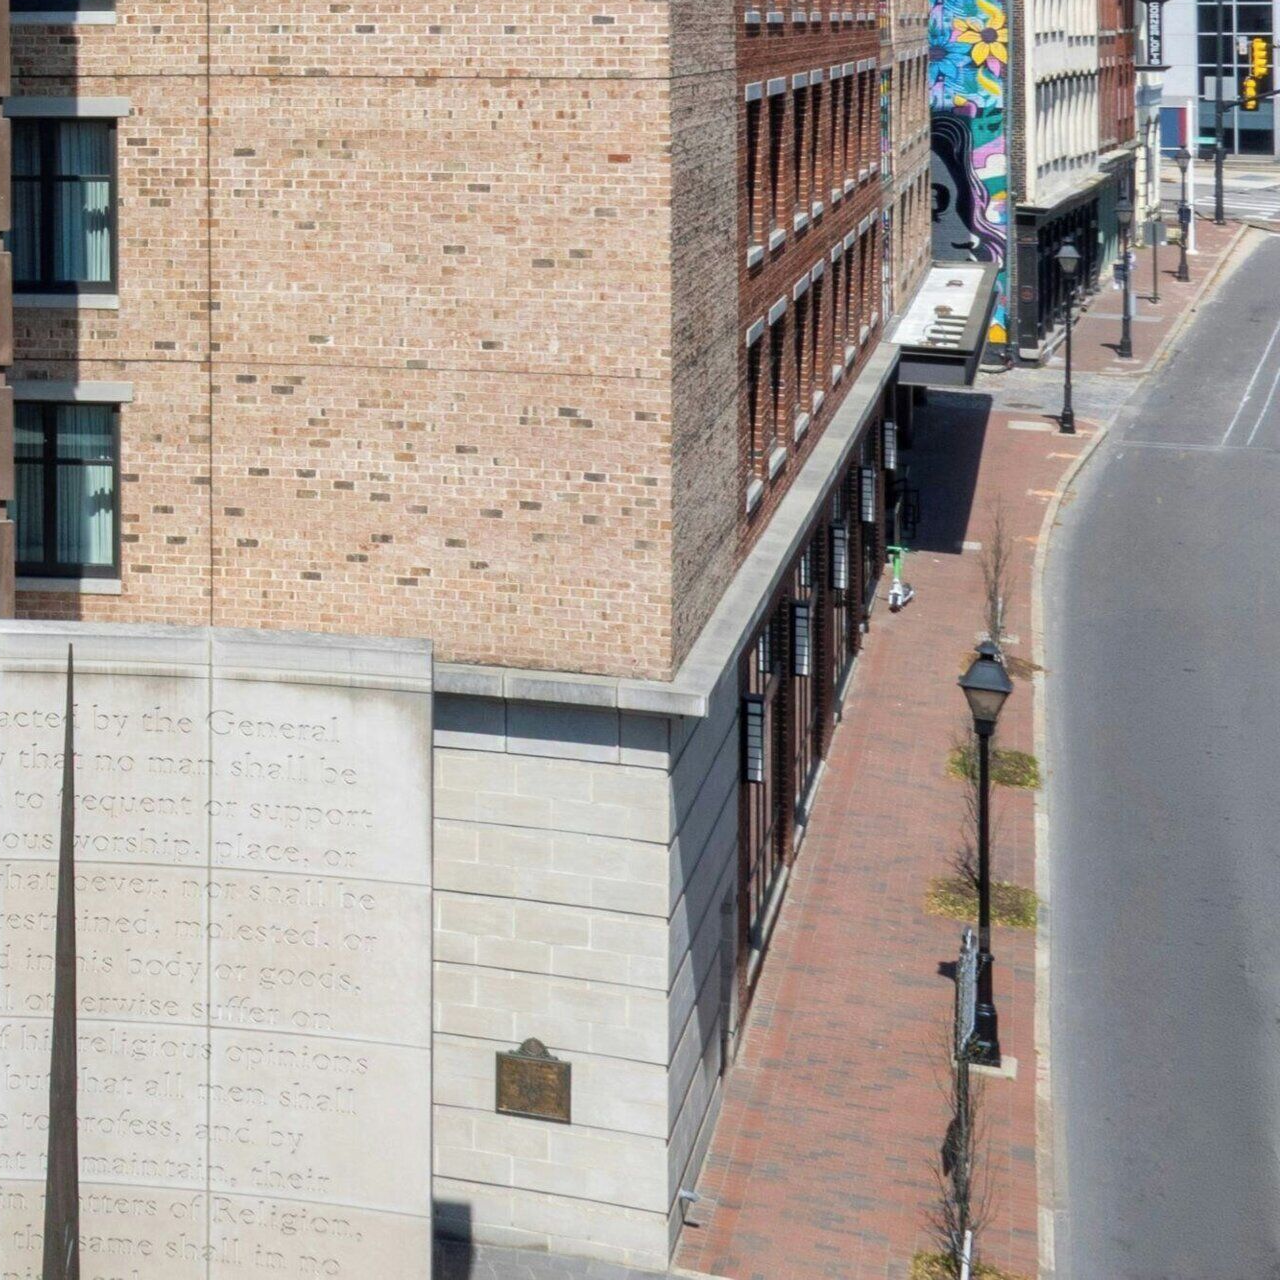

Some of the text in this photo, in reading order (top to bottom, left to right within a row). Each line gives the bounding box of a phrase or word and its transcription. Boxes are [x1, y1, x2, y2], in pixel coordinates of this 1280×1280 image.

[93, 704, 129, 737] by
[142, 706, 193, 734] the
[205, 709, 341, 743] General
[95, 753, 135, 773] no
[148, 755, 219, 776] man
[230, 752, 309, 783] shall
[319, 756, 358, 786] be
[15, 790, 44, 810] to
[204, 799, 238, 818] or
[249, 800, 374, 831] support
[323, 848, 362, 868] or
[182, 879, 237, 901] nor
[249, 876, 326, 907] shall
[337, 881, 376, 912] be
[344, 933, 378, 953] or
[26, 948, 55, 971] in
[125, 948, 202, 983] body
[215, 964, 247, 982] or
[25, 992, 180, 1017] oterwise
[192, 995, 280, 1025] suffer
[290, 1011, 336, 1031] on
[20, 1025, 53, 1052] hi
[77, 1028, 212, 1061] religious
[225, 1042, 369, 1076] opinions
[77, 1066, 133, 1096] hat
[144, 1071, 184, 1100] all
[197, 1083, 266, 1106] men
[279, 1081, 358, 1116] shall
[22, 1112, 50, 1131] to
[77, 1108, 182, 1142] rofess,
[195, 1118, 256, 1145] and
[267, 1120, 304, 1154] by
[251, 1160, 331, 1194] their
[170, 1194, 204, 1222] of
[13, 1224, 44, 1251] th
[77, 1234, 154, 1257] same
[166, 1232, 242, 1265] shall
[255, 1243, 287, 1270] in
[299, 1255, 341, 1276] no
